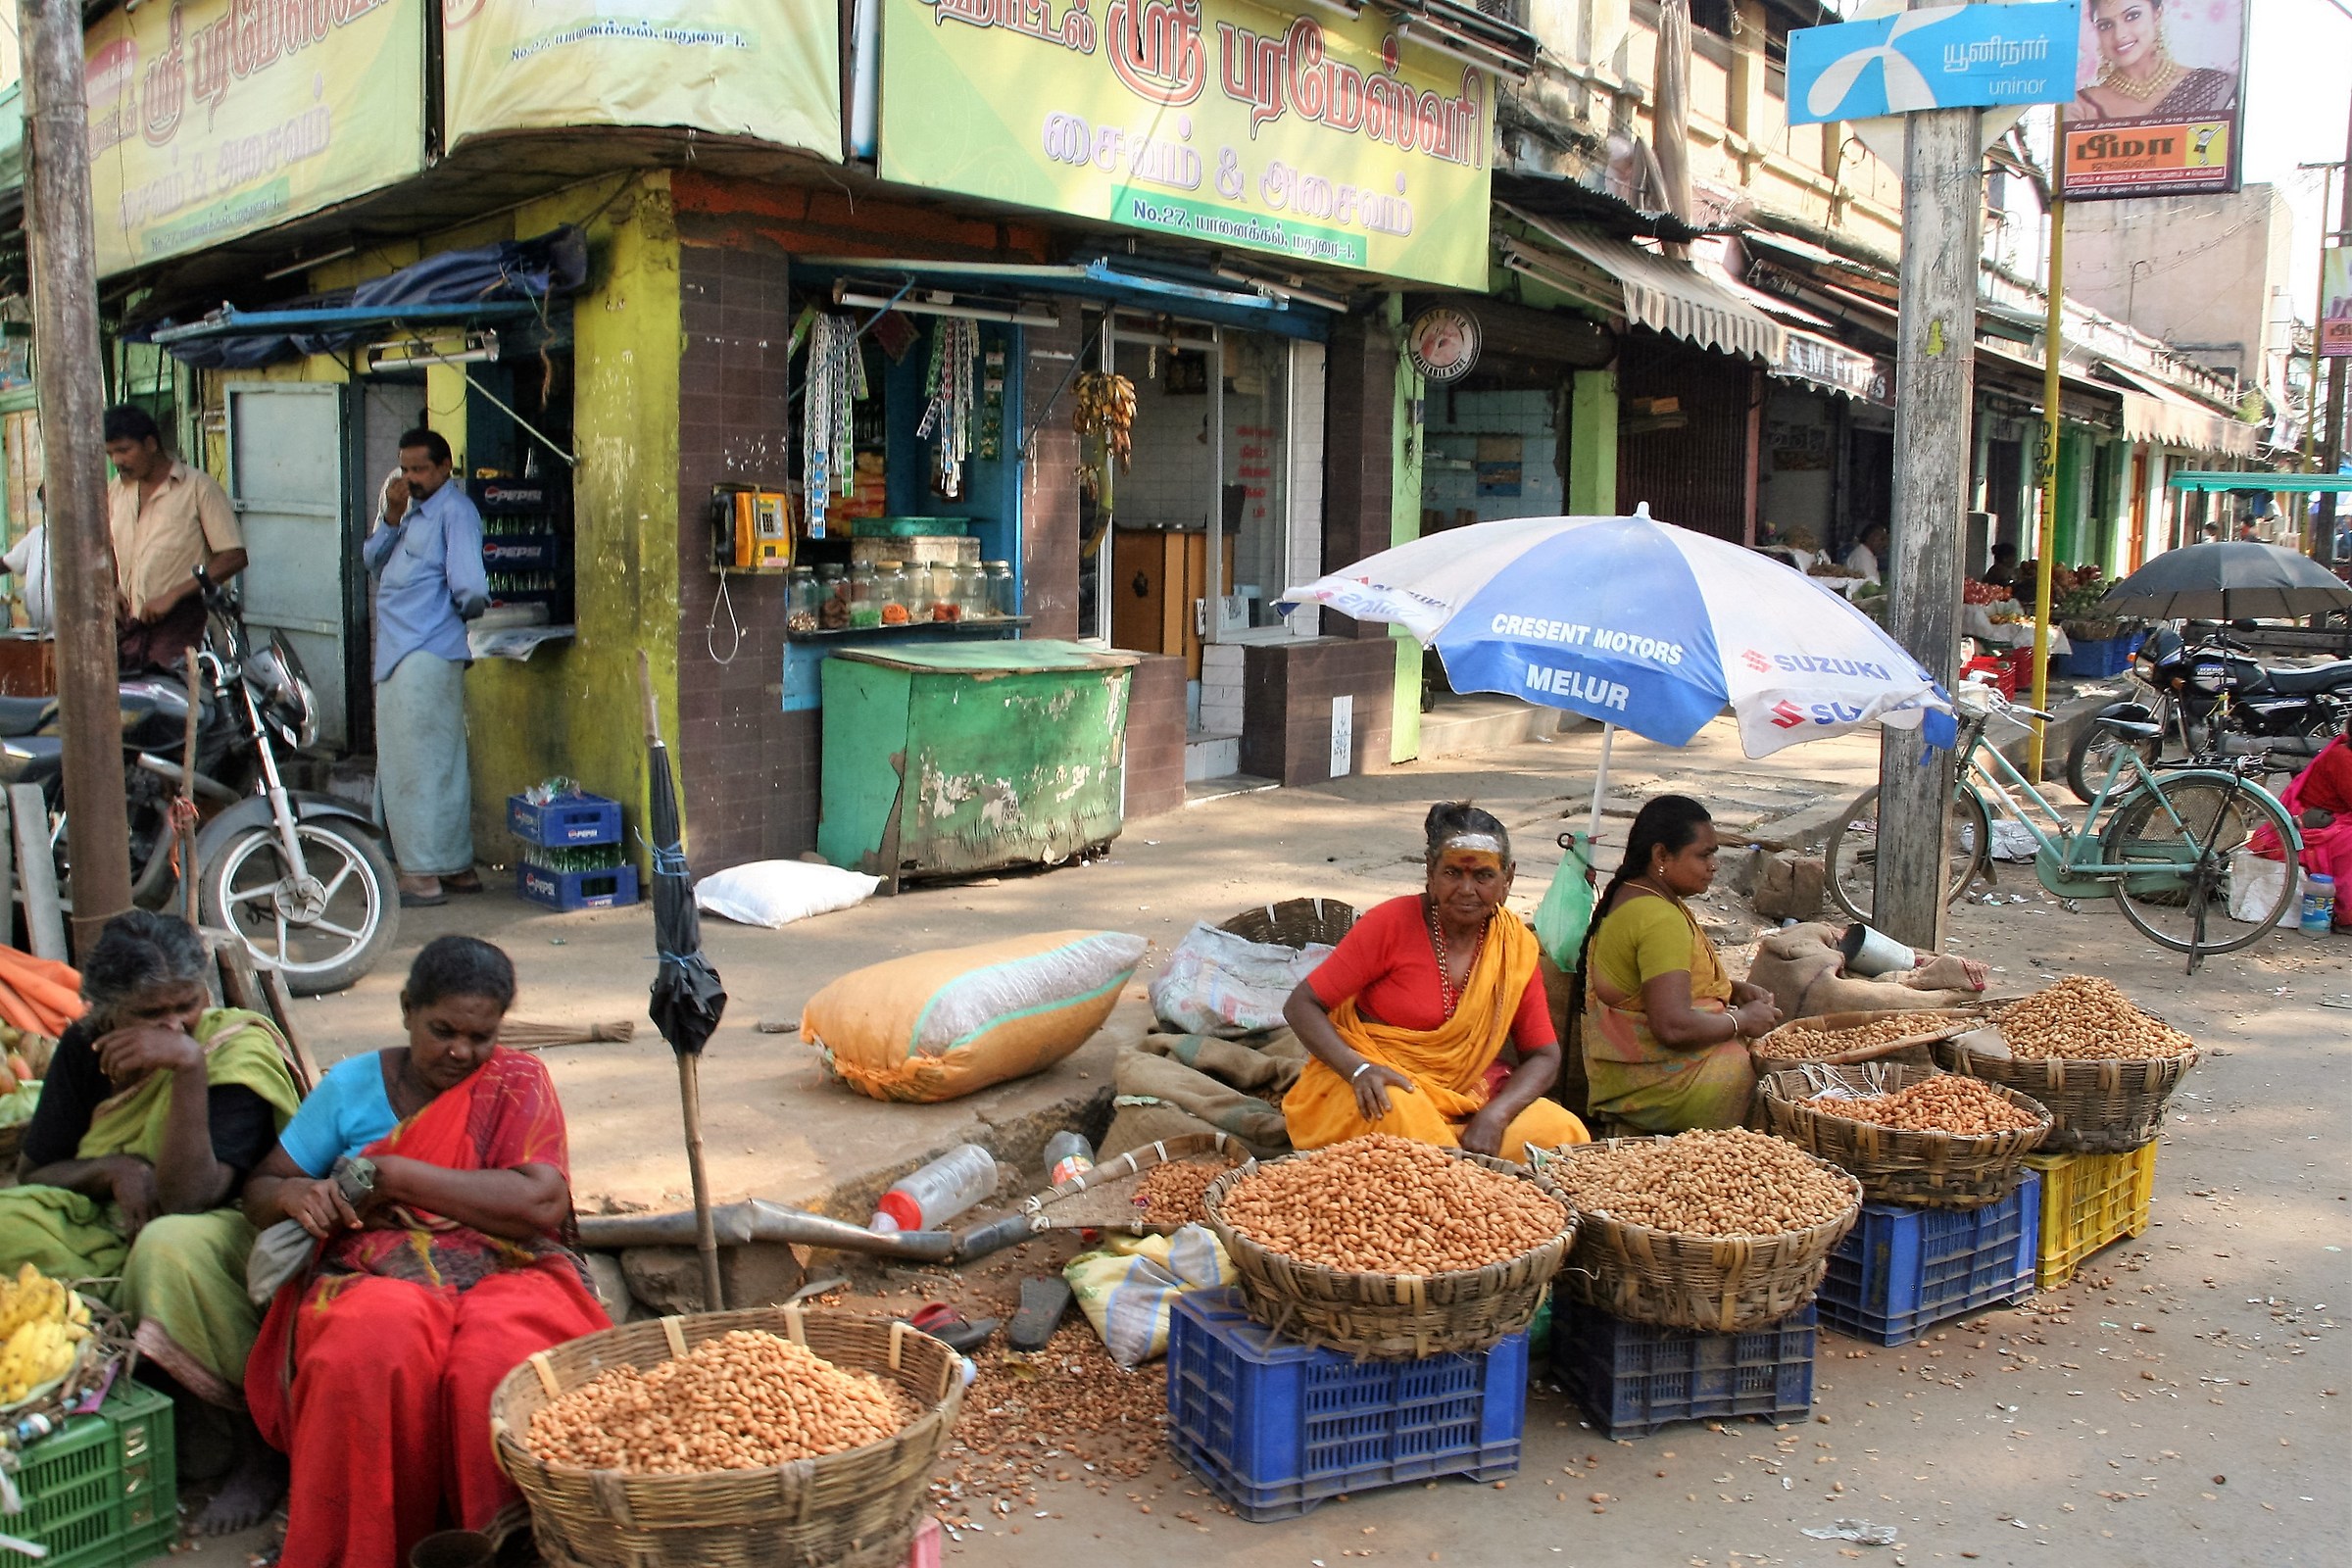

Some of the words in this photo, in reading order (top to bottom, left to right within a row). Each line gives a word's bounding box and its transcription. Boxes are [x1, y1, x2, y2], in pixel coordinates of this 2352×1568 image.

[1943, 33, 2049, 73] யூனிநார்
[1988, 75, 2046, 95] uninor
[2076, 133, 2176, 161] பீமா
[1042, 111, 1202, 191] சைவம்
[1214, 147, 1248, 203] &
[1258, 159, 1413, 237] அசைவம்
[497, 490, 542, 501] PEPSI
[496, 547, 541, 557] PEPSI
[1491, 612, 1591, 646] CRESENT
[1593, 628, 1684, 665] MOTORS
[1774, 654, 1892, 681] SUZUKI
[1525, 663, 1630, 711] MELUR
